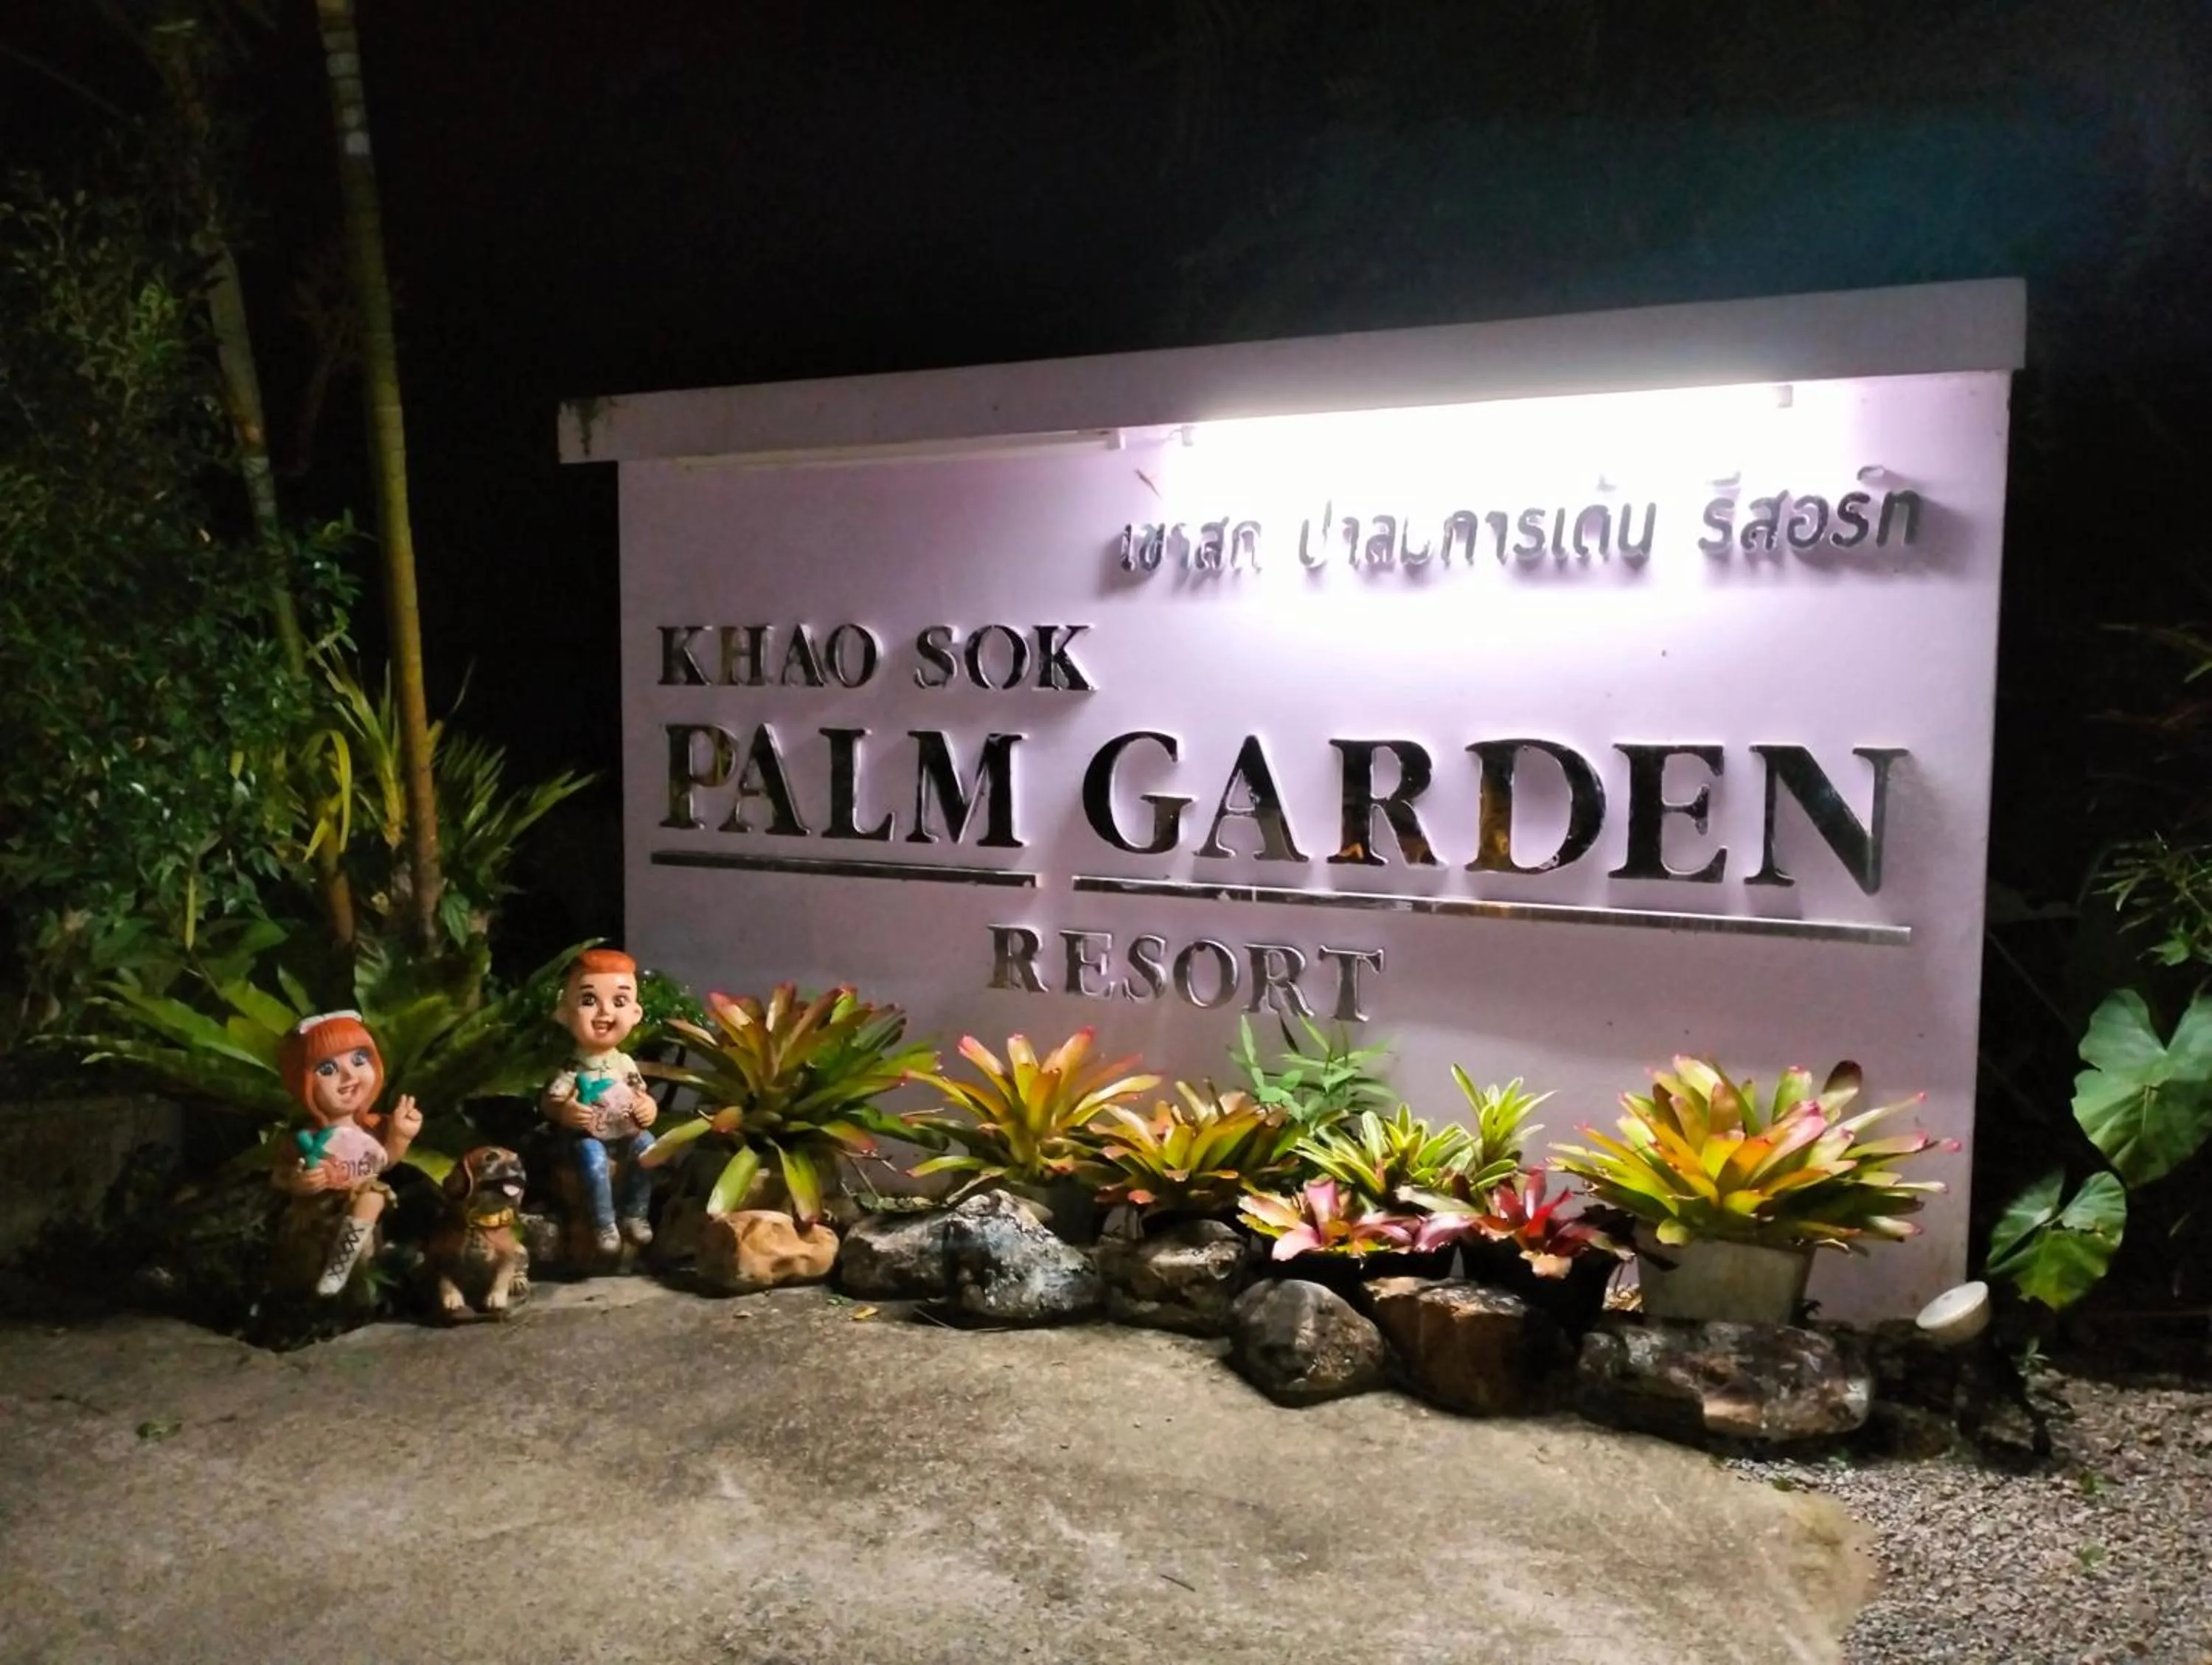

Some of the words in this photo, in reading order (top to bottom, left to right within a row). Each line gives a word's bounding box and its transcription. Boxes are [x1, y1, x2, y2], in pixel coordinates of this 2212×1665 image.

[658, 625, 883, 689] KHAO
[914, 624, 1099, 691] SOK
[658, 722, 1029, 848] PALM
[1082, 729, 1909, 894] GARDEN
[987, 924, 1385, 1022] RESORT
